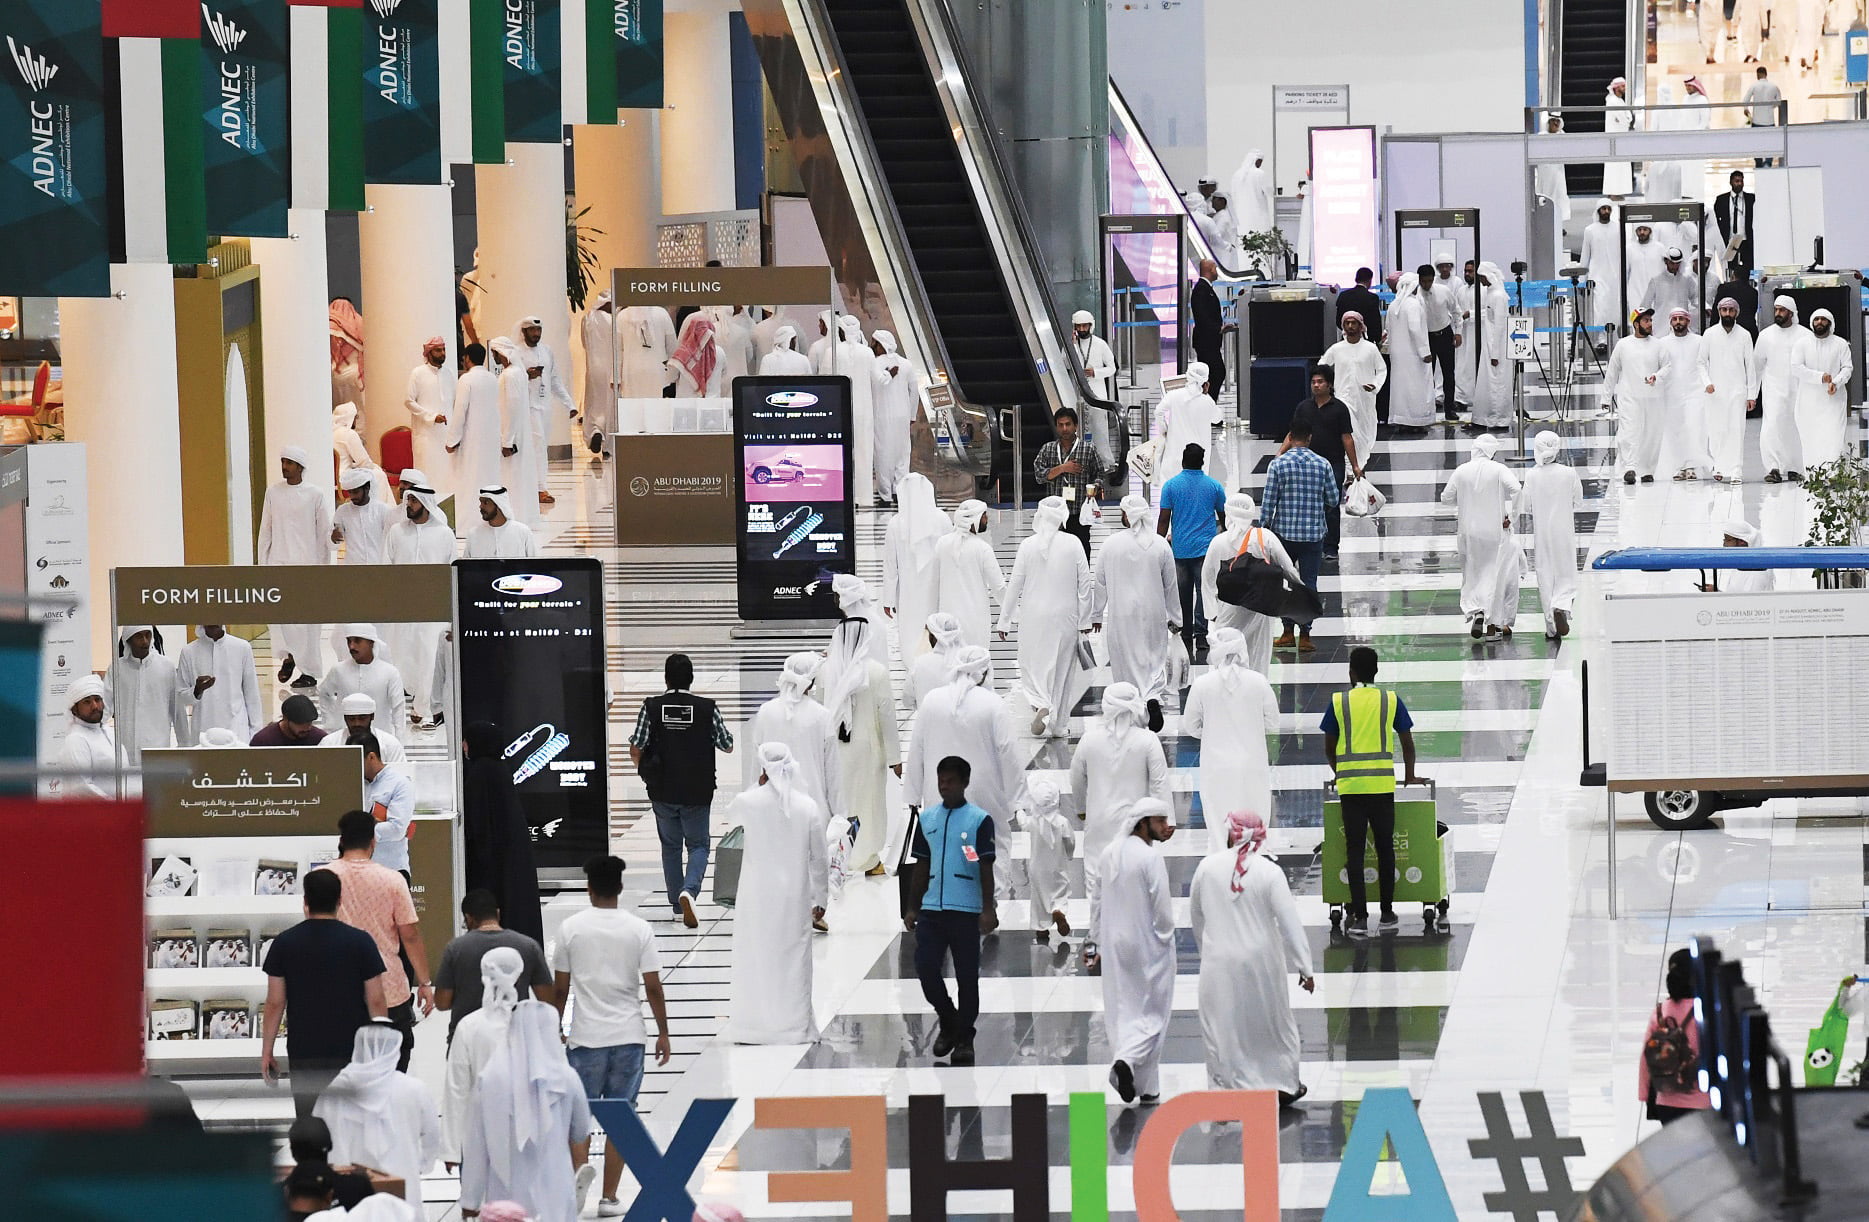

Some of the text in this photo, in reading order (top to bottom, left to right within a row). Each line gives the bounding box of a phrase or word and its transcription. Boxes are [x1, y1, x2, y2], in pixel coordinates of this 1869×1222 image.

[506, 0, 523, 70] ADNEC
[379, 25, 398, 104] ADNEC
[221, 61, 241, 149] ADNEC
[31, 101, 55, 197] ADNEC
[631, 281, 721, 293] FORM FILLING
[1515, 320, 1528, 331] EXIT
[654, 477, 722, 486] ABU DHABI 2019
[141, 587, 282, 604] FORM FILLING
[773, 586, 802, 595] ADNEC
[191, 768, 308, 789] اكتشف
[410, 885, 425, 893] HABI
